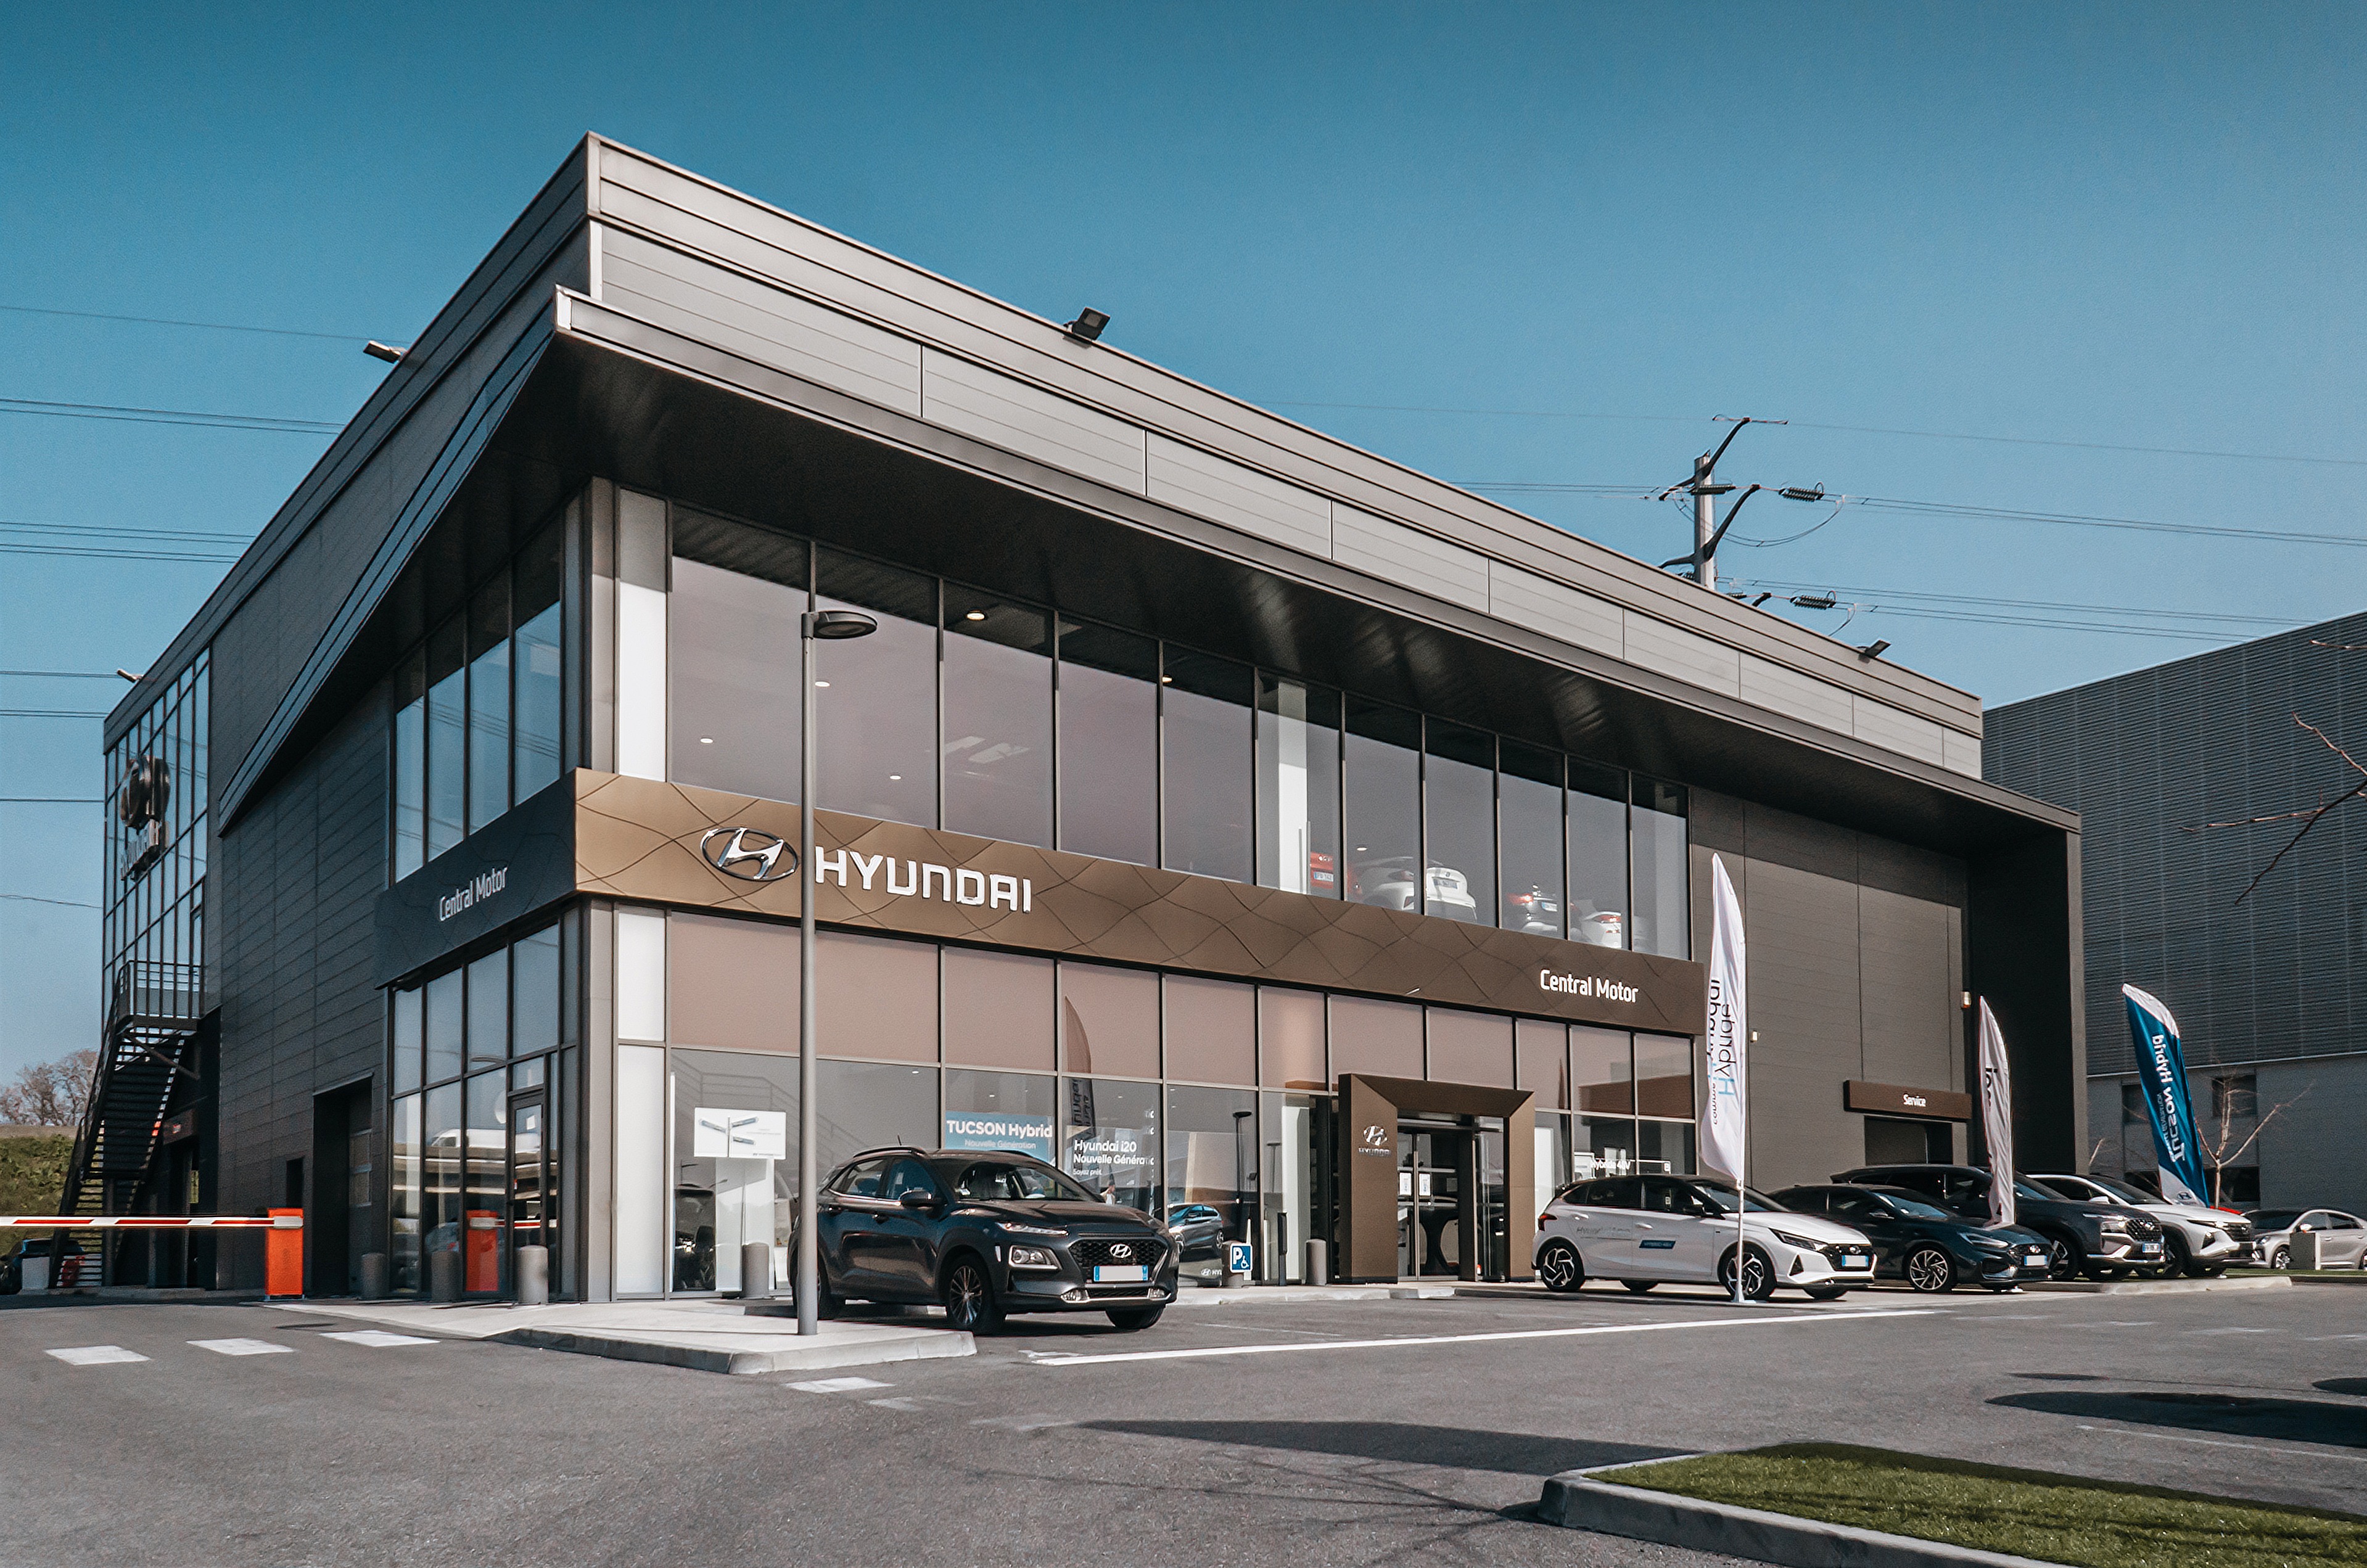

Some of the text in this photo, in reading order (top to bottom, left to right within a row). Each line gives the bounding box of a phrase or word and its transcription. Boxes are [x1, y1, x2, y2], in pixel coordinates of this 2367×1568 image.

[815, 845, 1032, 914] HYUNDAI
[439, 867, 508, 921] Central Motor
[1540, 969, 1639, 1003] Central Motor
[1903, 1094, 1927, 1107] Service
[946, 1120, 1053, 1139] TUCSON Hybrid
[965, 1139, 1037, 1149] Nouvelle Génération
[1074, 1139, 1137, 1153] Hyundai i20
[1073, 1154, 1112, 1164] Nouvelle
[1233, 1246, 1243, 1265] P
